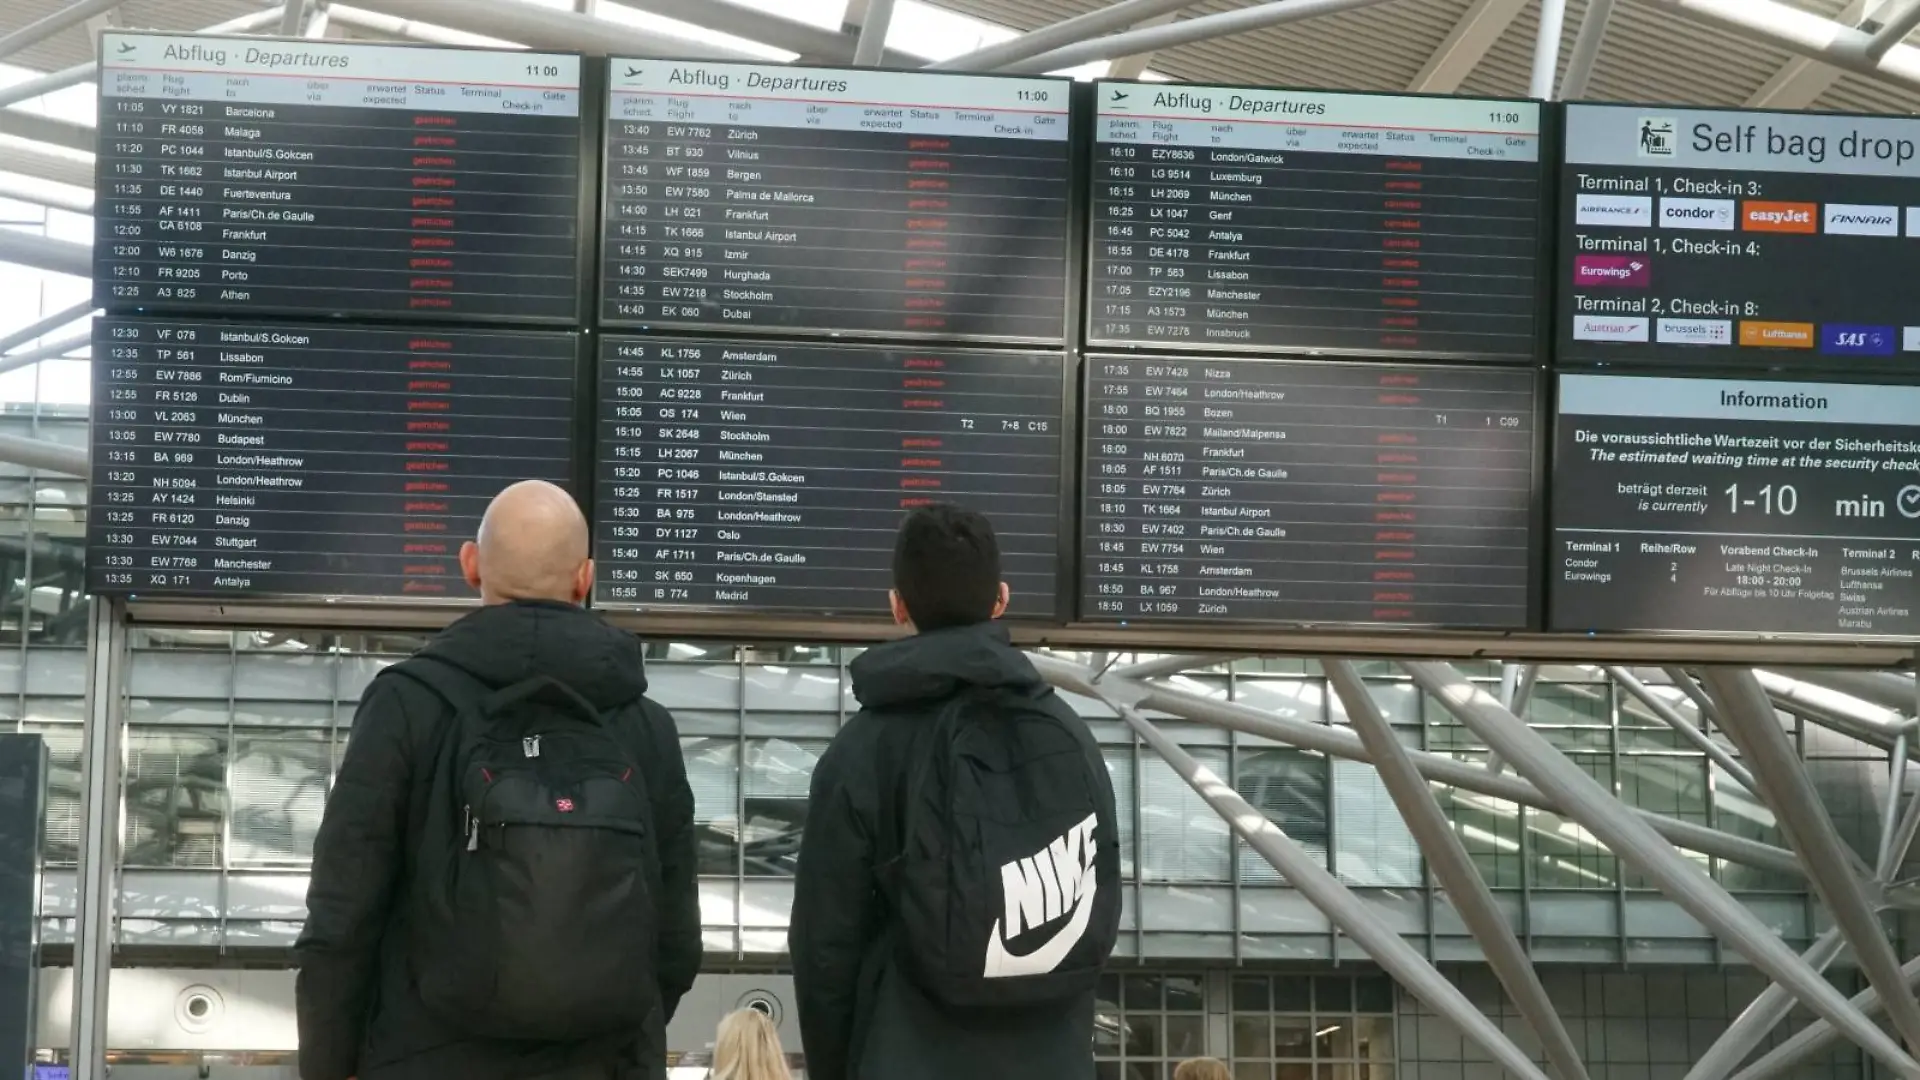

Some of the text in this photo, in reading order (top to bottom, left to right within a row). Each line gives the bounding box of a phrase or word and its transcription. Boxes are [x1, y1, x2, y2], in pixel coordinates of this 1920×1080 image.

[164, 44, 349, 69] Abflug Departures
[415, 85, 566, 101] Status Terminal Gate
[669, 68, 1048, 101] Abflug Departures 11:00
[163, 86, 543, 110] Flight Check-in
[1154, 92, 1519, 123] Abflug Departures 11:00
[668, 110, 1033, 135] Flight Check-in
[910, 110, 1056, 125] Status Terminal Gate
[116, 123, 143, 133] 11:10
[162, 125, 177, 134] FR
[225, 127, 260, 138] Malaga
[1152, 121, 1526, 147] Flug Status Terminal Gate
[116, 144, 142, 153] 11:20
[161, 145, 176, 155] PC
[180, 146, 203, 155] 1044
[623, 145, 759, 160] 13:45 BT 930 Vilnius
[1152, 132, 1505, 156] Flight Check-in
[1692, 123, 1915, 166] Self bag drop
[622, 165, 762, 181] 13:45 WF 1859 Bergen
[1576, 173, 1762, 196] Terminal 1, Check-in 3:
[1108, 187, 1252, 202] 16:15 LH 2069 München
[1108, 206, 1232, 220] 16:25 LX 1047 Genf
[1580, 206, 1892, 225] AIRFRANCE condor easyJet FINNAIR
[1576, 235, 1760, 256] Terminal 1, Check-in 4:
[1581, 266, 1631, 279] Eurowings
[1574, 295, 1759, 316] Terminal 2, Check-in 8:
[1584, 323, 1867, 346] Austrian brussels Lufthansa SAS
[110, 390, 250, 403] 12:55 FR 5126 Dublin
[617, 387, 764, 401] 15:00 AC 9228 Frankfurt
[1720, 390, 1828, 409] Information
[616, 407, 1047, 431] 15:05 OS 174 Wien T2 7+8 C15
[1102, 405, 1519, 427] 18:00 BQ 1955 Bozen T1 1 C09
[109, 431, 264, 446] 13:05 EW 7780 Budapest
[1575, 430, 1598, 444] Die
[1602, 432, 1712, 447] voraussichtliche
[1714, 434, 1779, 450] Wartezeit
[1783, 440, 1805, 449] vor
[1809, 438, 1831, 450] der
[1590, 448, 1920, 472] The estimated waiting time at the security check
[1618, 482, 1885, 517] beträgt derzeit 1-10 min
[1638, 500, 1708, 514] is currently
[1100, 543, 1224, 555] 18:45 EW 7754 Wien
[1566, 541, 1920, 559] Terminal 1 Reihe/Row Vorabend Check-In Terminal 2 R
[1565, 558, 1598, 568] Condor
[1671, 562, 1677, 571] 2
[1726, 563, 1744, 572] Late
[1747, 563, 1771, 574] Night
[1841, 566, 1878, 577] Brussels
[1881, 568, 1912, 577] Airlines
[1565, 571, 1883, 589] Eurowings 4 18:00 20:00 Lufthansa
[1840, 592, 1866, 602] Swiss
[1838, 606, 1909, 616] Austrian Airlines
[1838, 618, 1872, 629] Marabu
[1001, 812, 1098, 940] NIKE
